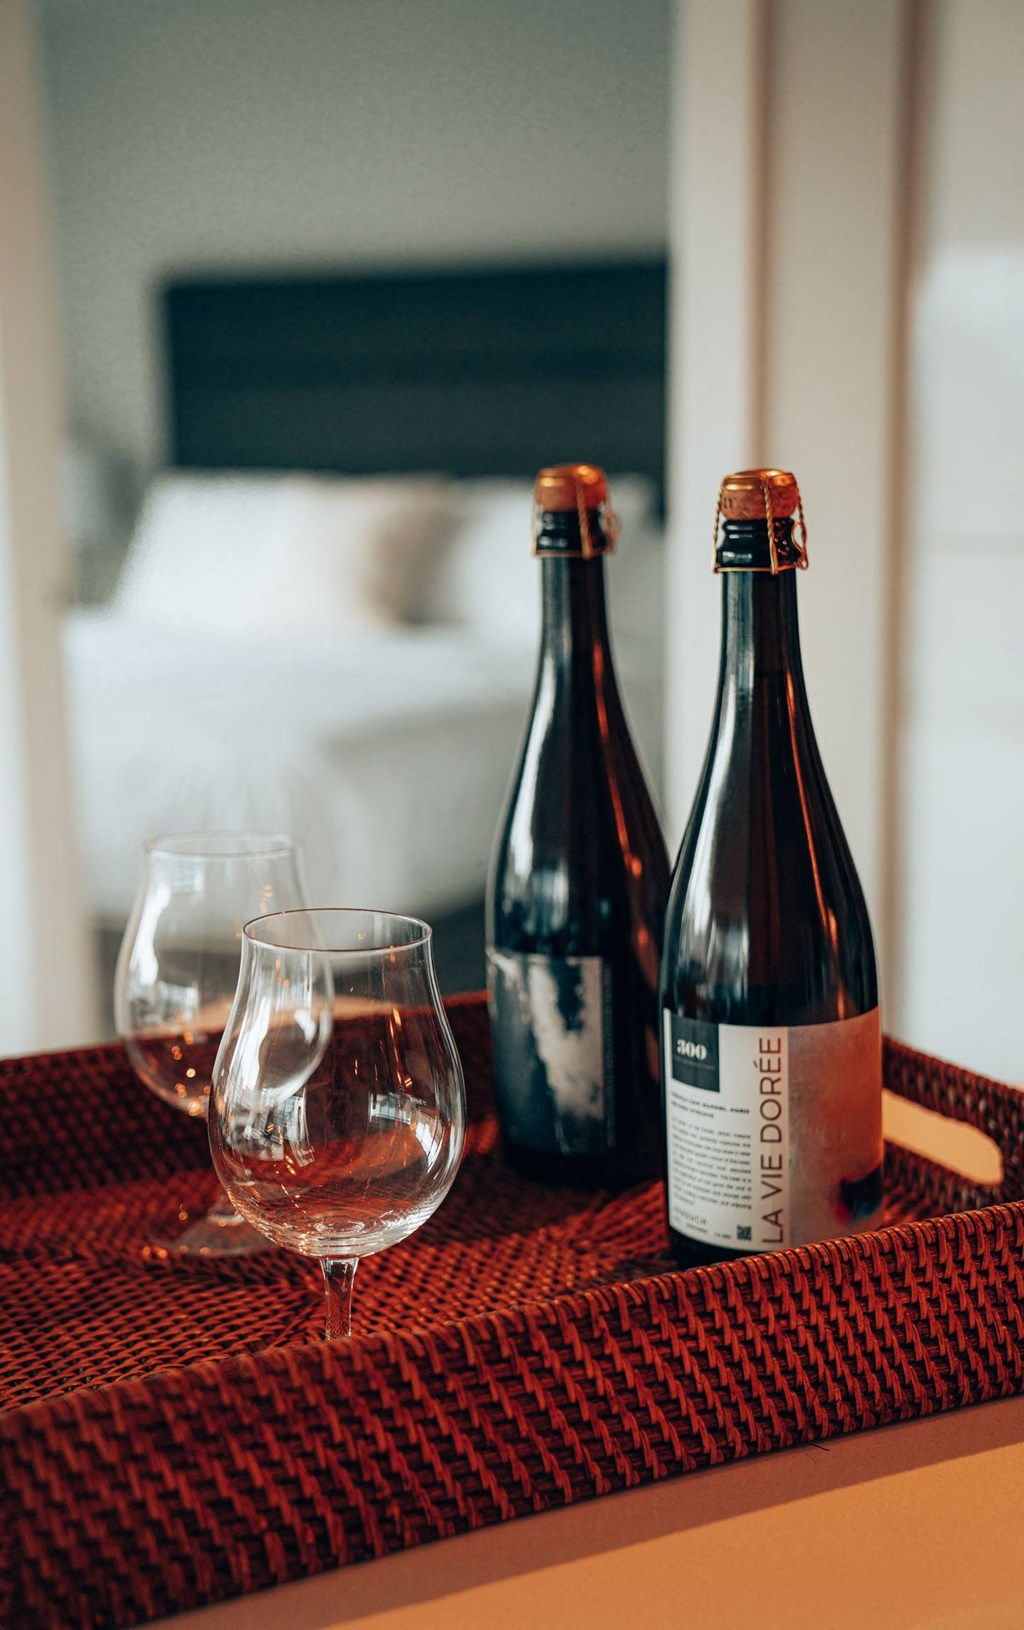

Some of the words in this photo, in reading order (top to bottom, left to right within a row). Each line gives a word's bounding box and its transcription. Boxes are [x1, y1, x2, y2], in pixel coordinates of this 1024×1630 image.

[677, 1039, 707, 1061] 300
[753, 1037, 782, 1144] DORÉE
[760, 1154, 783, 1200] VIE
[761, 1209, 784, 1244] LA
